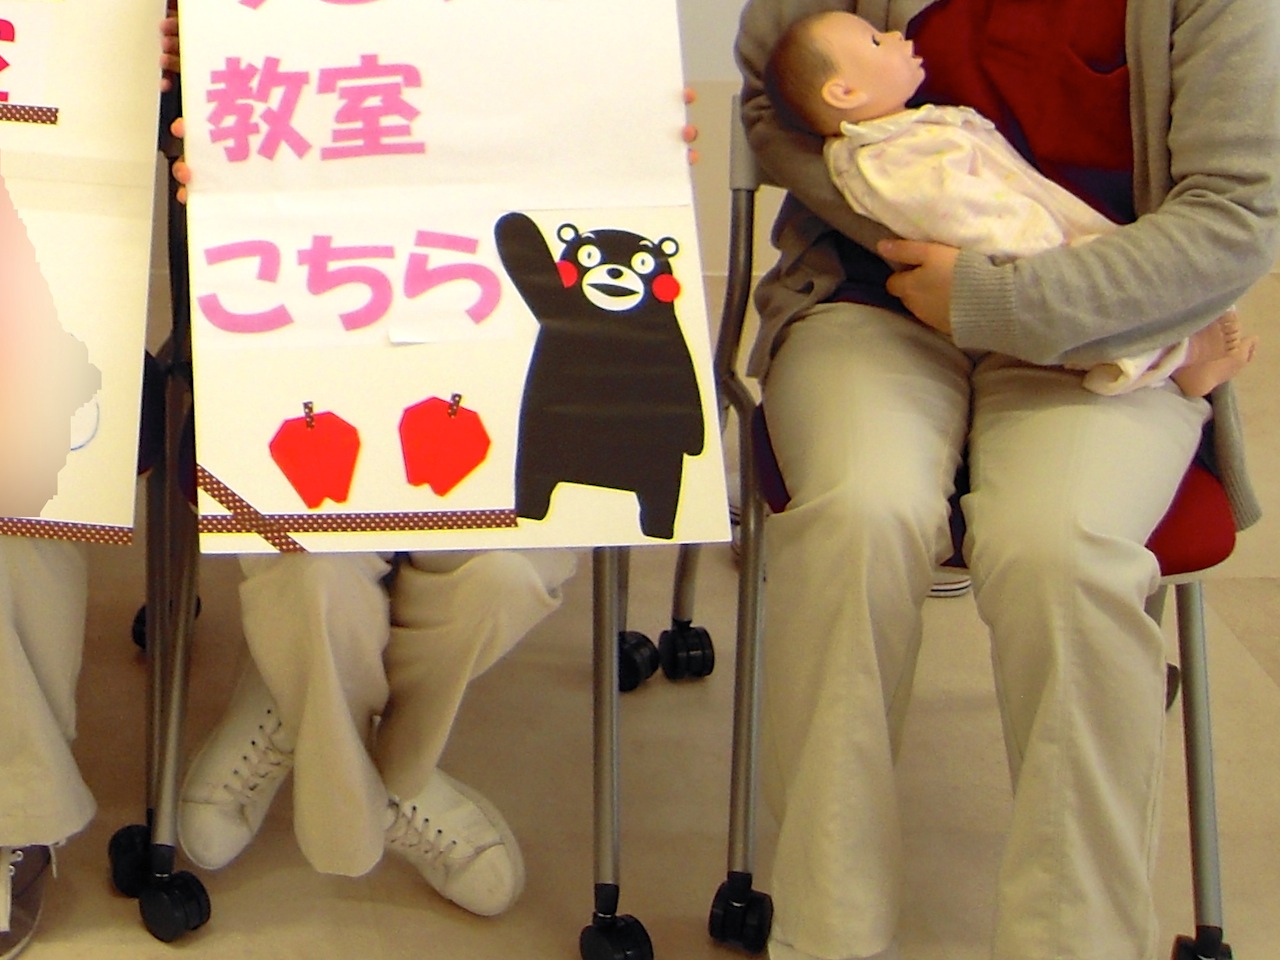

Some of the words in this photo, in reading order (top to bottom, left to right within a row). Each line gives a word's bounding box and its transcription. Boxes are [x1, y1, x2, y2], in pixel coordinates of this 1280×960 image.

[206, 54, 425, 163] 教室
[196, 231, 502, 333] こちら
